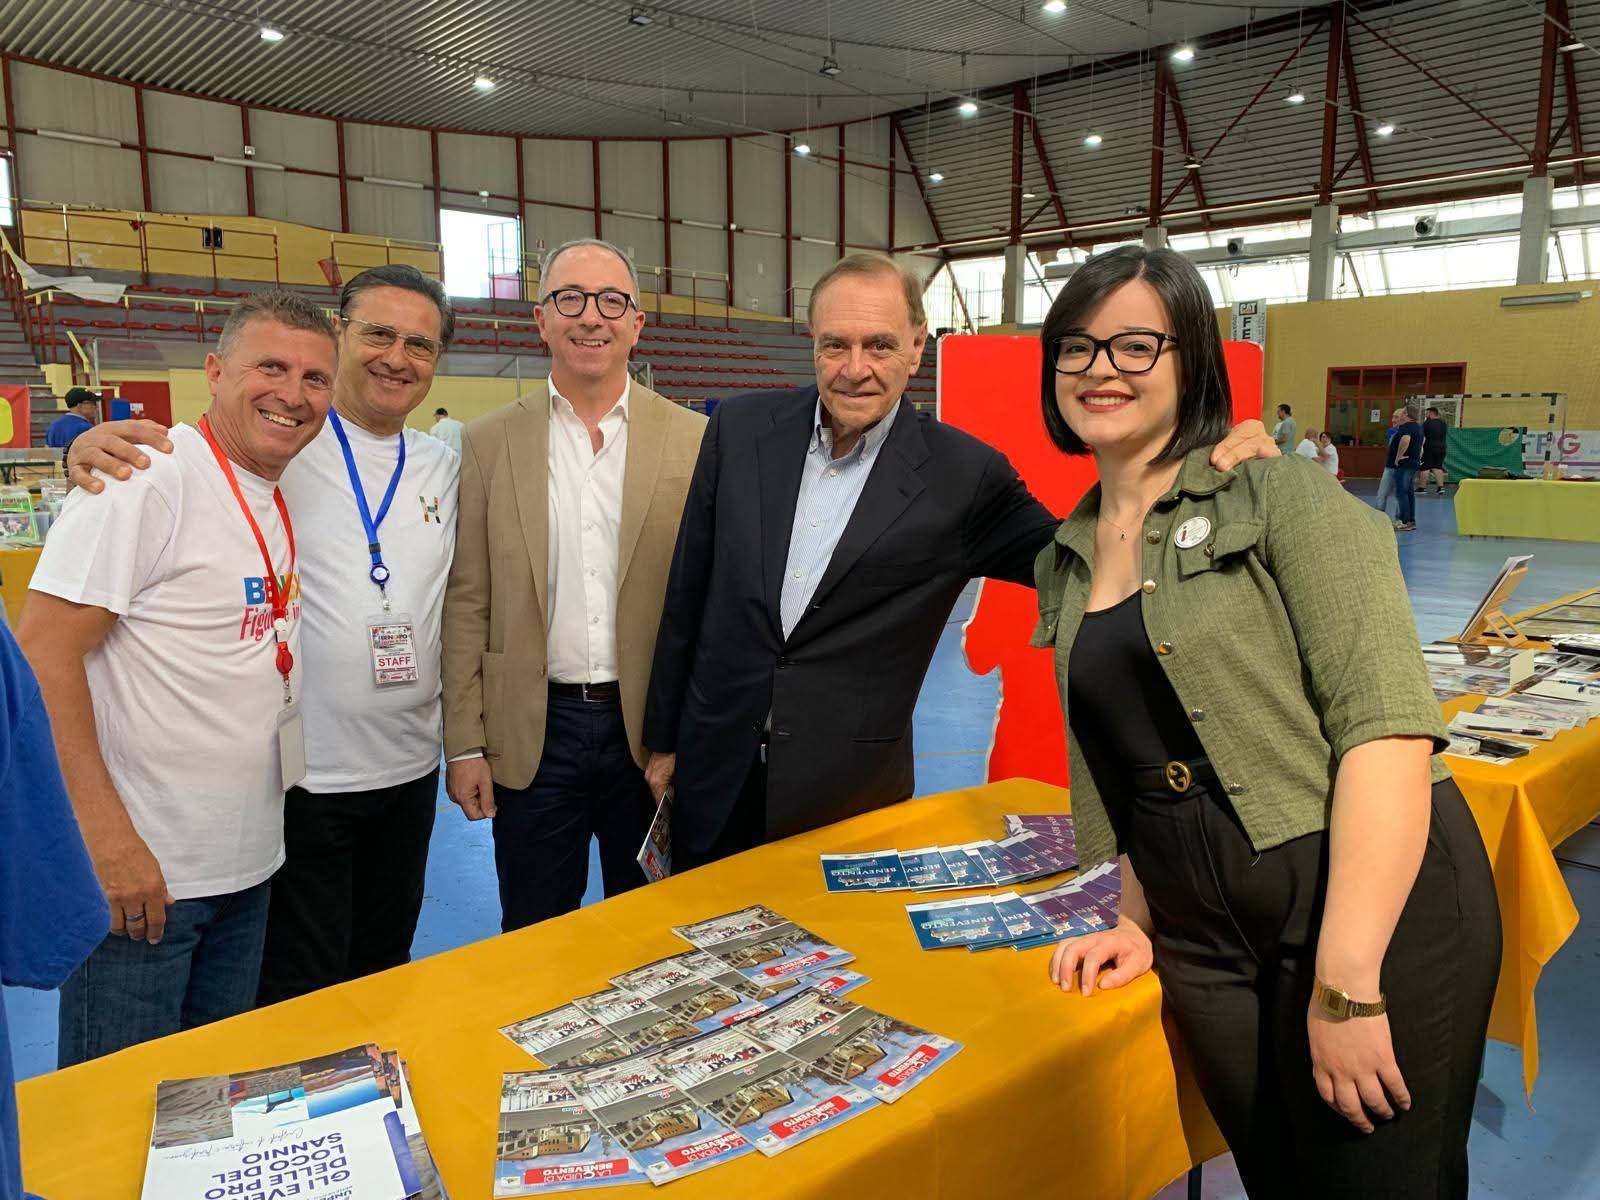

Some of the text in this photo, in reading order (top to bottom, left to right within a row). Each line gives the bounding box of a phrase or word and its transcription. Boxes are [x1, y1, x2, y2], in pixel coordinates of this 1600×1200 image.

[378, 656, 410, 667] STAFF
[831, 867, 897, 877] BENEVENTO
[920, 915, 996, 930] BENEVENTO
[708, 1047, 761, 1073] EXPERT
[782, 1101, 835, 1127] BENEVENTO
[242, 1133, 342, 1165] SANNIO
[212, 1144, 344, 1184] LOCO DEL
[543, 1162, 613, 1176] BENEVENTO
[204, 1157, 347, 1200] DELLE PRO
[310, 1170, 350, 1190] GLI
[543, 1175, 555, 1183] DI
[597, 1169, 612, 1177] LA
